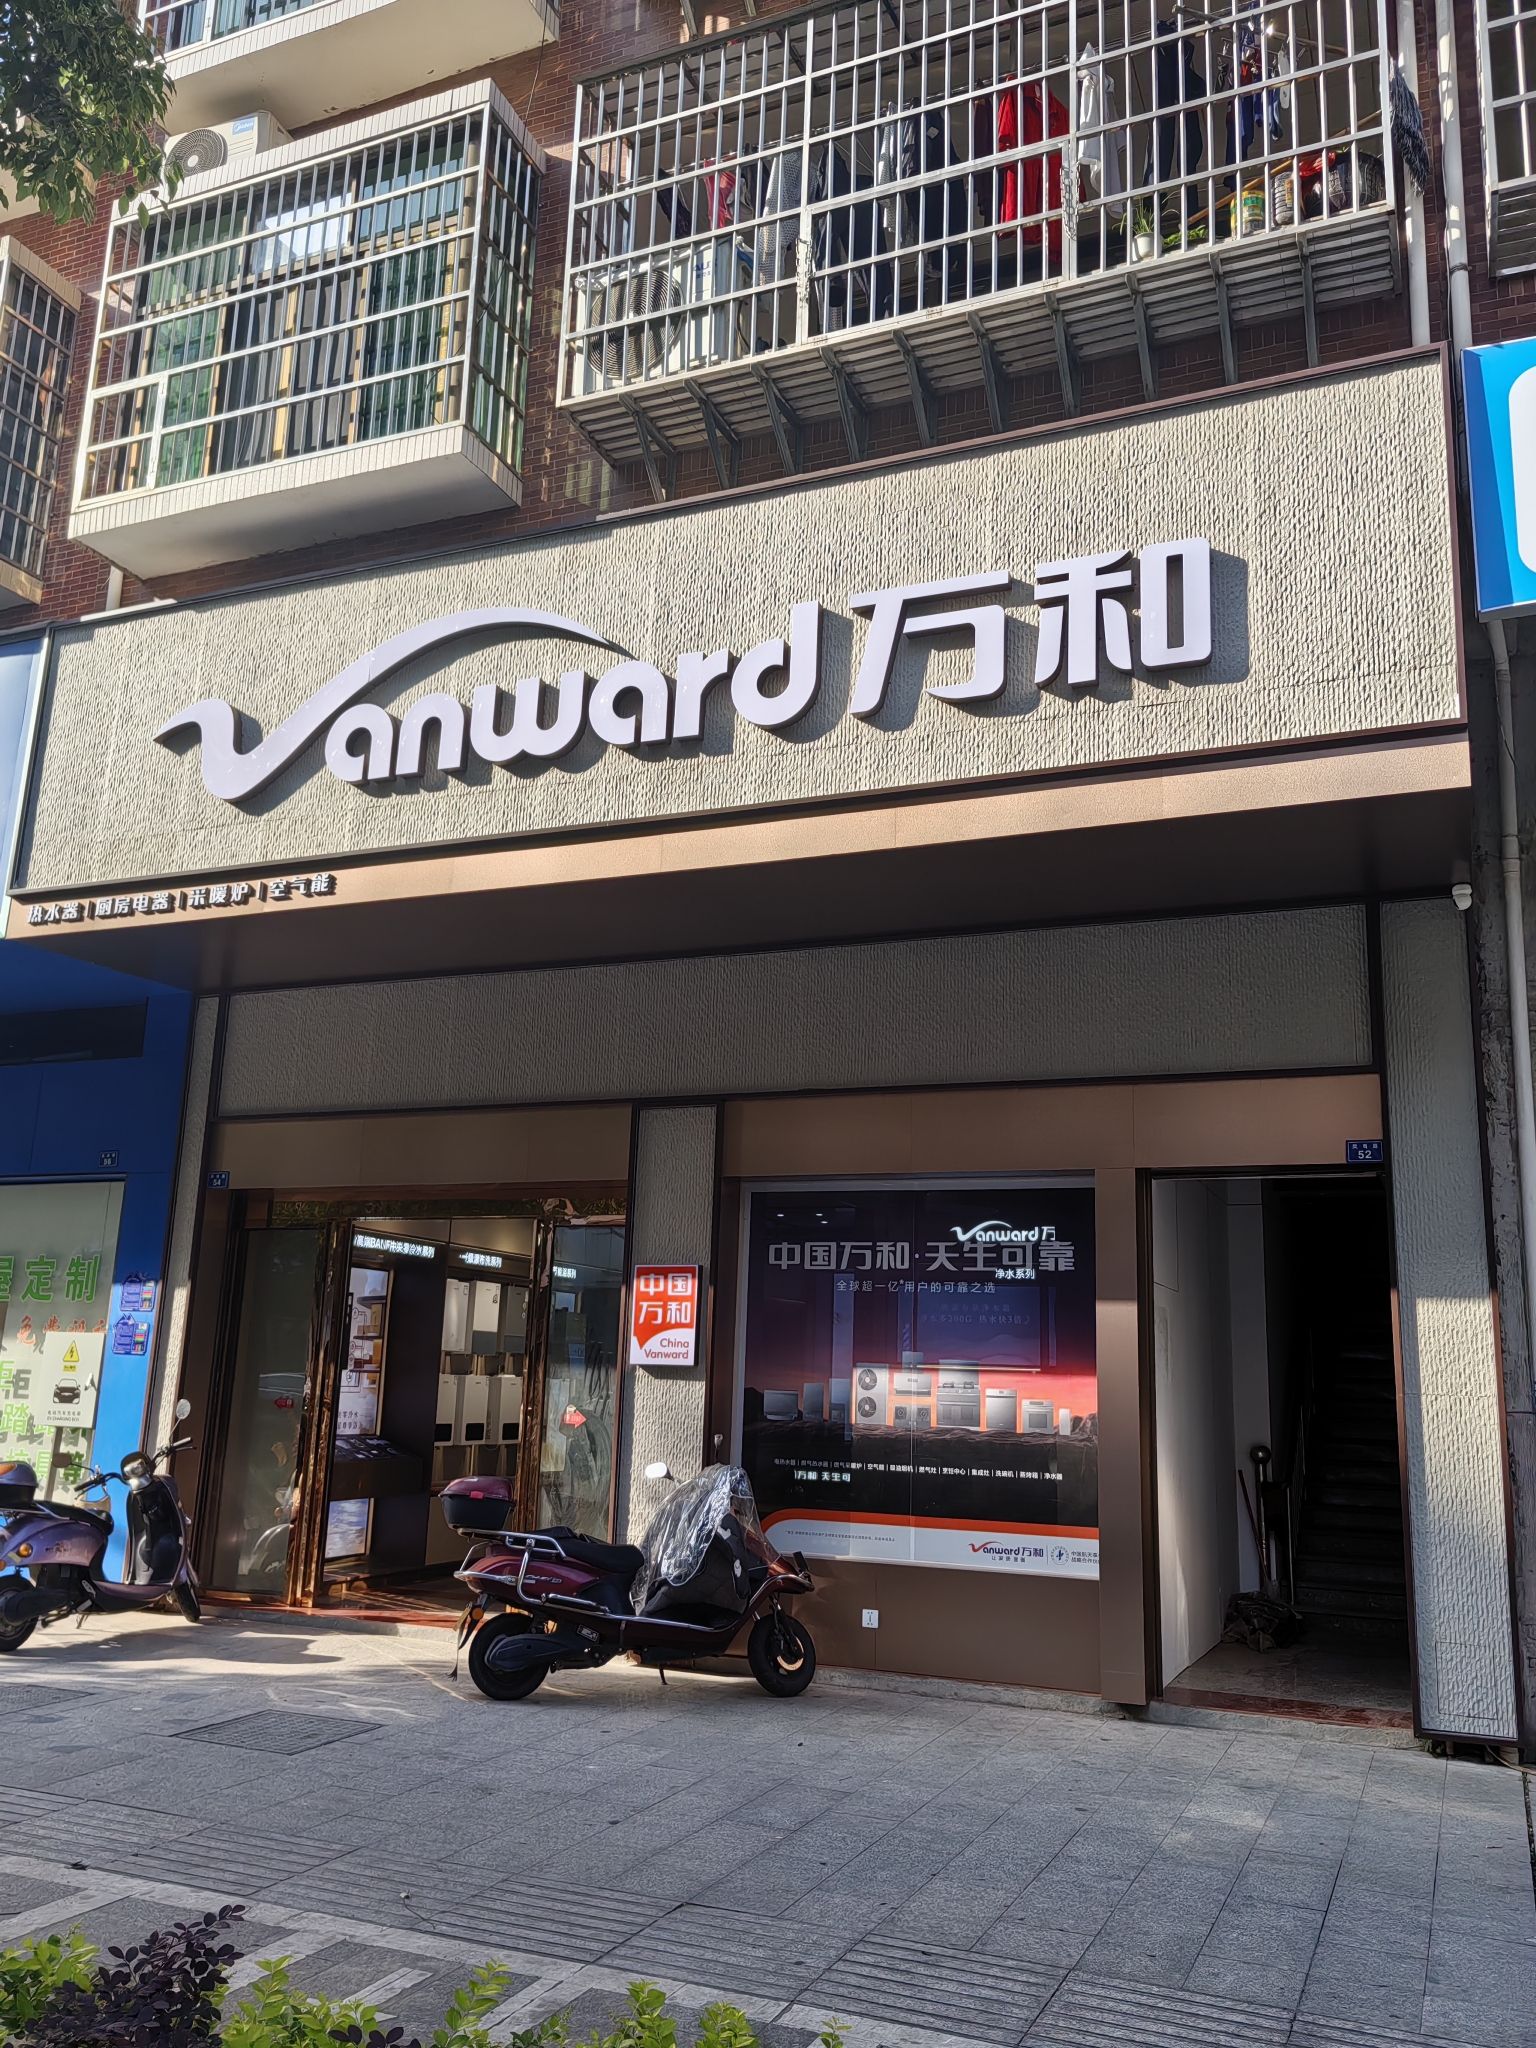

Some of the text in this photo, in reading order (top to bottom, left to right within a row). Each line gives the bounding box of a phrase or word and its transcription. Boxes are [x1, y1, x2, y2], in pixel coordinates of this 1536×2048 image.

[153, 536, 1213, 802] Vanward 万和
[27, 873, 334, 924] 热水器 厨房电器 采暖炉 空气能
[1358, 1150, 1372, 1159] 52
[950, 1221, 1038, 1242] Vanward
[995, 1268, 1036, 1280] 净水系列
[640, 1273, 692, 1296] 中国
[639, 1301, 691, 1325] 万和
[660, 1338, 690, 1349] China
[644, 1349, 689, 1359] Vanward
[969, 1541, 1020, 1556] Vanward
[1021, 1547, 1044, 1557] 万和
